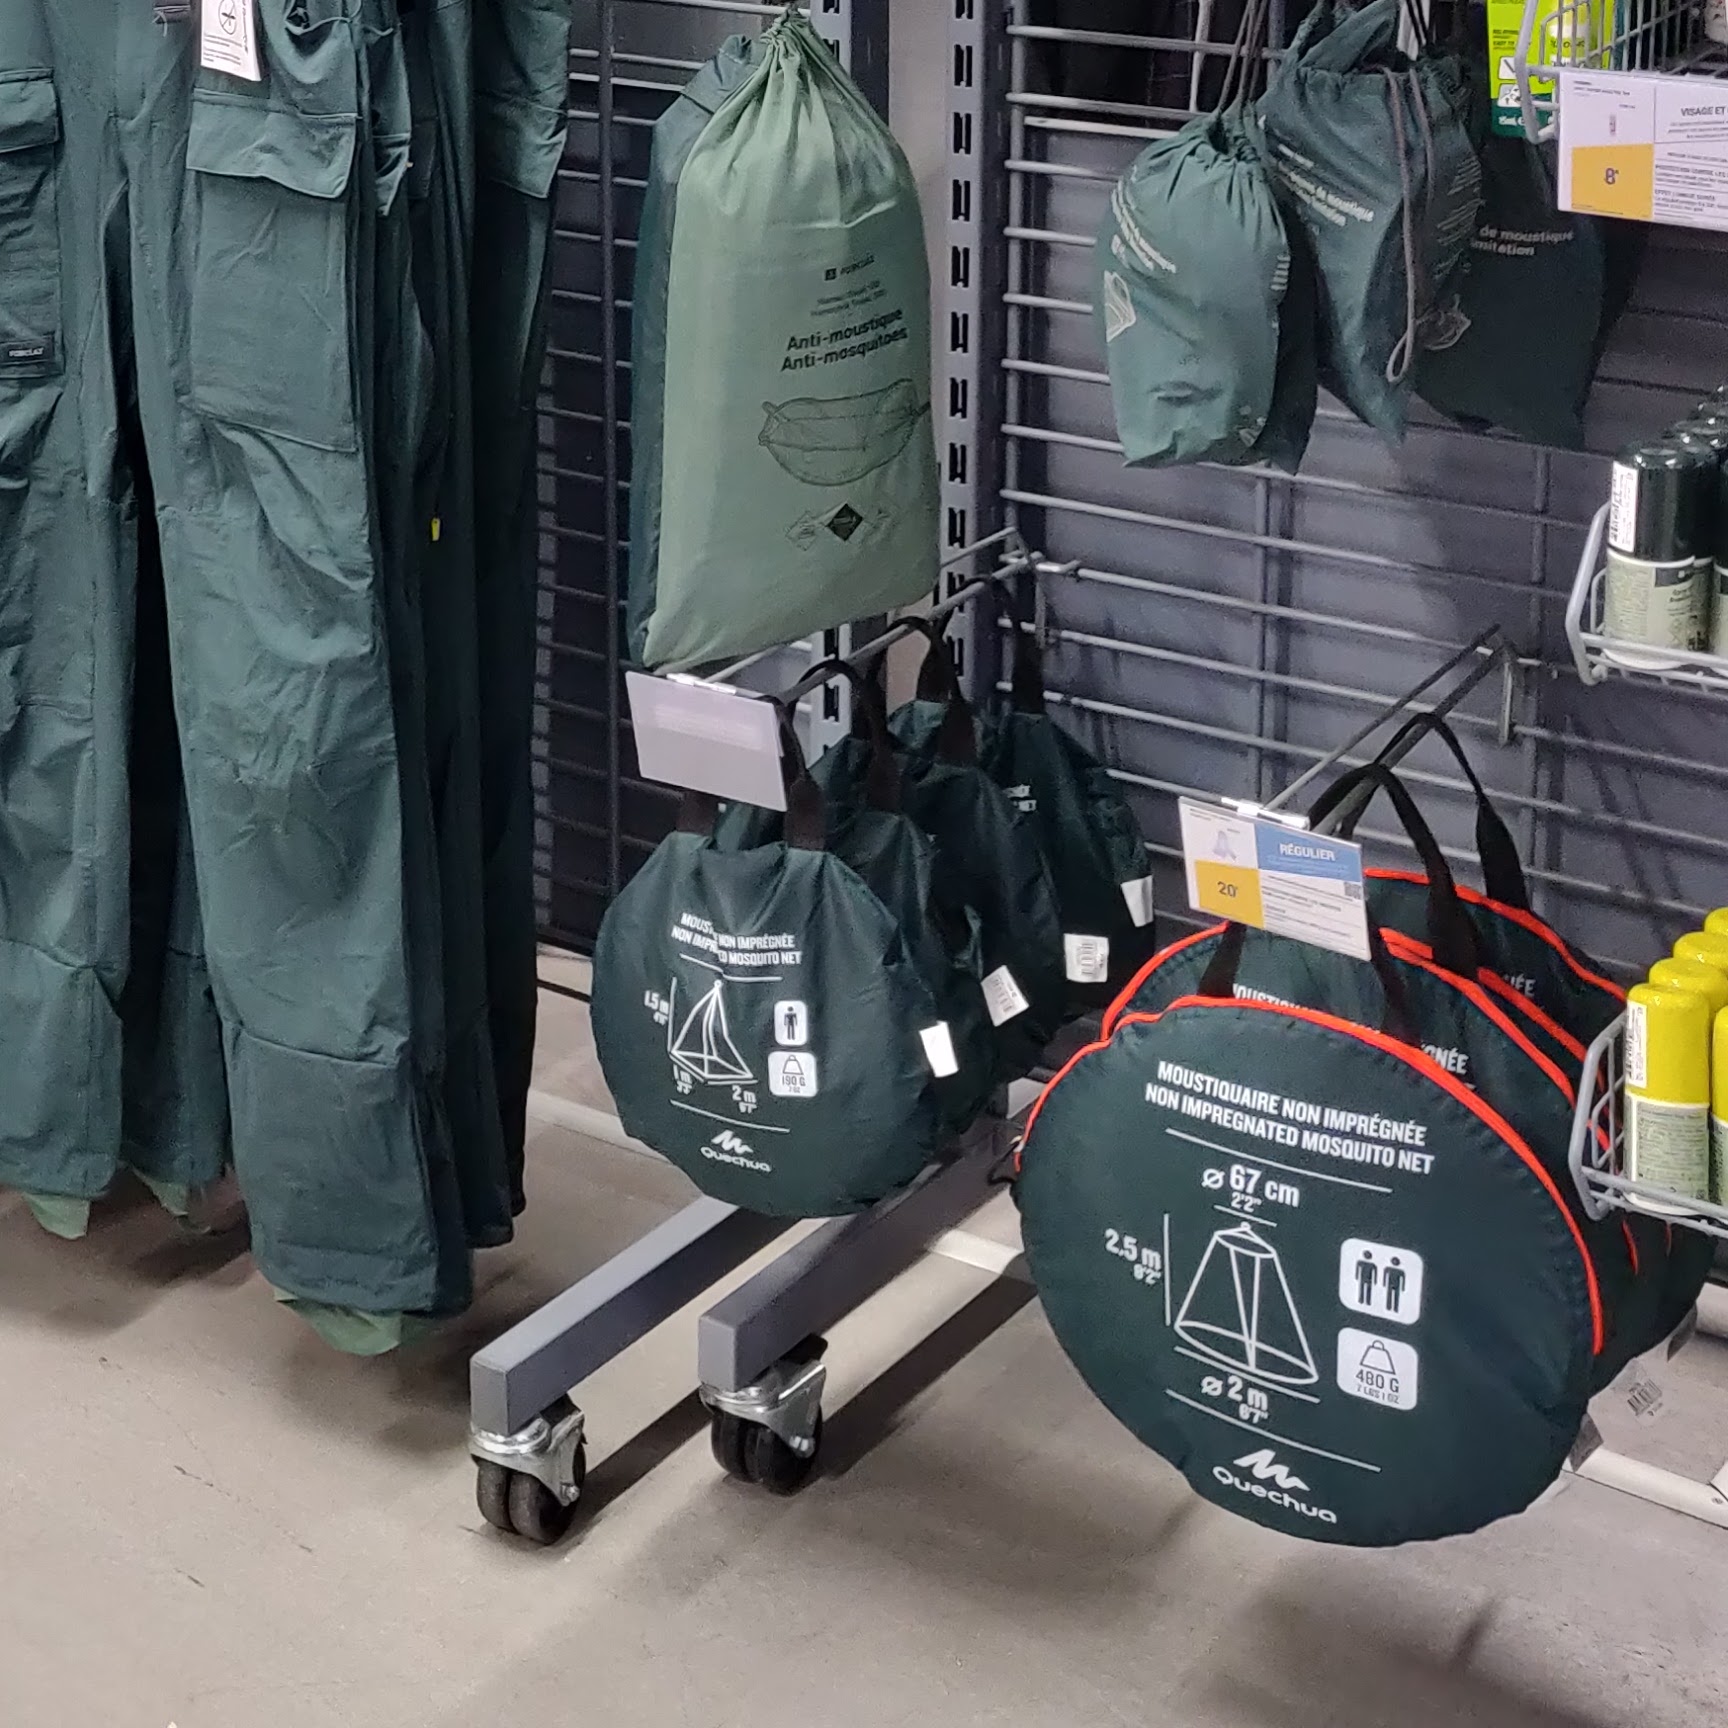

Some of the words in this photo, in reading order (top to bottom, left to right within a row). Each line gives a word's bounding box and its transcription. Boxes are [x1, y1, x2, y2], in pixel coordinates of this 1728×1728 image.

[1680, 106, 1714, 117] VISAGE
[1715, 106, 1726, 116] ET
[786, 308, 903, 352] Anti-moustique
[1279, 842, 1336, 862] RÉGULIER
[671, 924, 693, 945] NON
[728, 950, 780, 966] MOSQUITO
[781, 950, 803, 965] NET
[737, 932, 796, 950] IMPRÉGNÉE
[732, 1085, 742, 1101] 2
[743, 1090, 757, 1104] m
[782, 1076, 798, 1087] 190
[799, 1076, 806, 1087] G
[1157, 1060, 1282, 1115] MOUSTIQUAIRE
[1282, 1098, 1322, 1126] NON
[1323, 1106, 1428, 1147] IMPRÉGNÉE
[1145, 1082, 1180, 1111] NON
[1181, 1095, 1299, 1148] IMPREGNATED
[1301, 1129, 1395, 1168] MOSQUITO
[1397, 1153, 1435, 1175] NET
[700, 1145, 771, 1173] Quechua
[1229, 1164, 1262, 1192] 67
[1265, 1179, 1300, 1208] cm
[1141, 1246, 1162, 1271] m
[1226, 1375, 1242, 1402] 2
[1247, 1387, 1269, 1412] m
[1355, 1368, 1385, 1390] 480
[1389, 1377, 1400, 1393] G
[1212, 1464, 1338, 1524] Quechua
